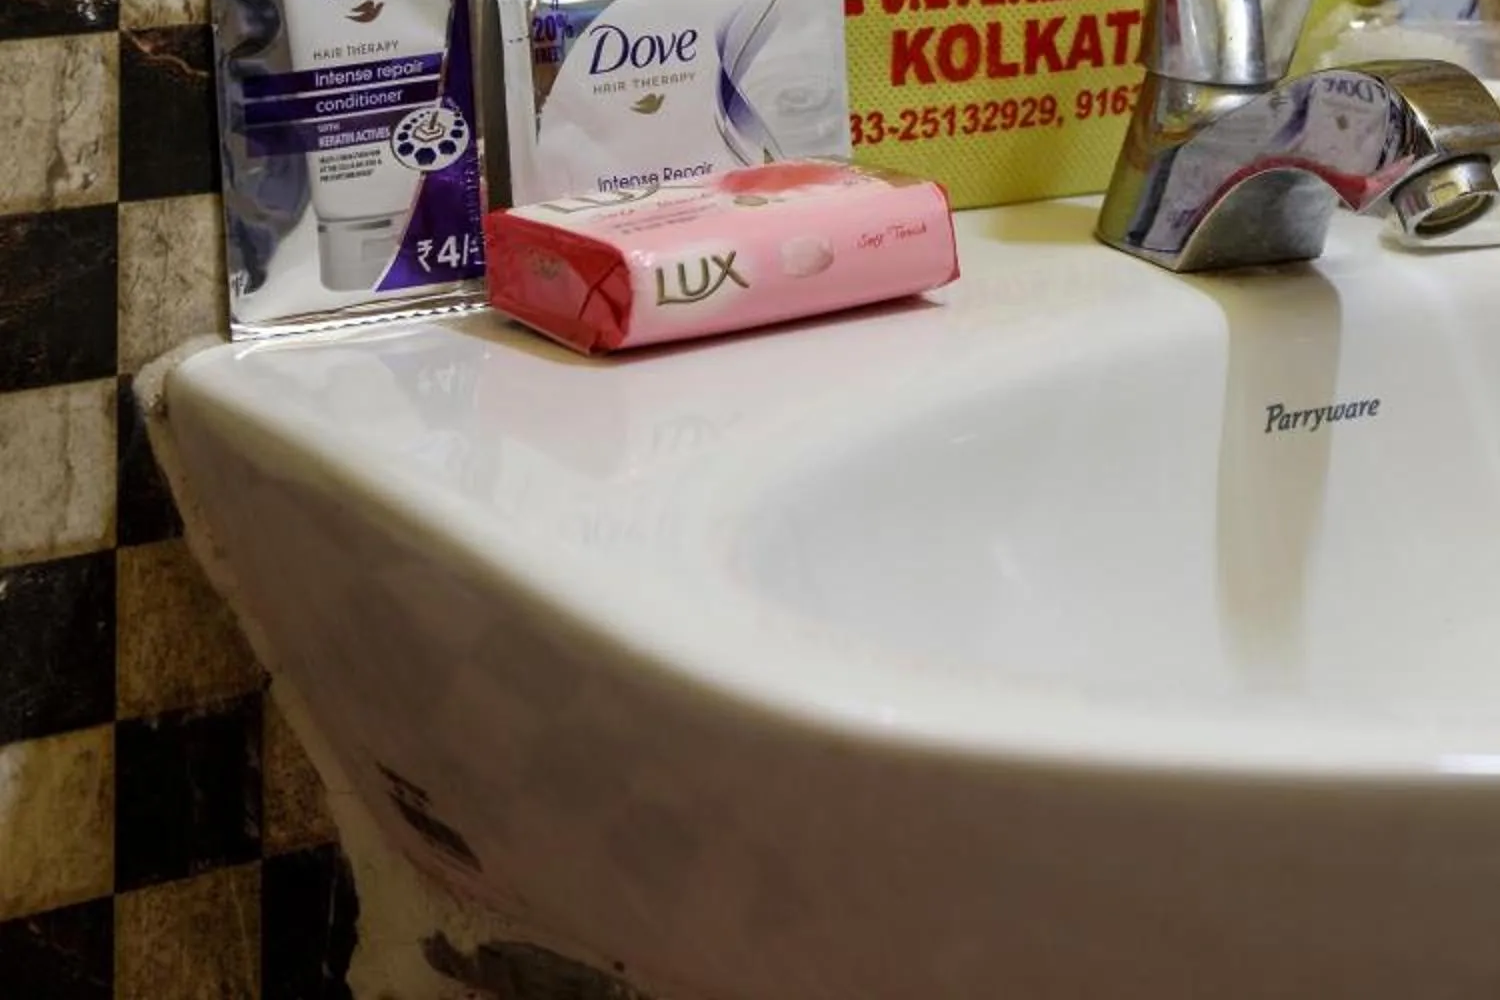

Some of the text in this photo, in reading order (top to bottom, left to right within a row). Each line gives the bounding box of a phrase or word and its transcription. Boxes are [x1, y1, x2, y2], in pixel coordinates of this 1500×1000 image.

[313, 40, 399, 61] HAIR THERAPY
[589, 24, 698, 75] Dove
[890, 8, 1145, 87] KOLKAT
[315, 60, 425, 88] Intense repair
[593, 72, 696, 95] HAIR THERAPY
[315, 89, 402, 113] conditioner
[597, 161, 713, 193] Intense Repair
[656, 250, 750, 306] LUX
[1264, 398, 1381, 433] Parryware
